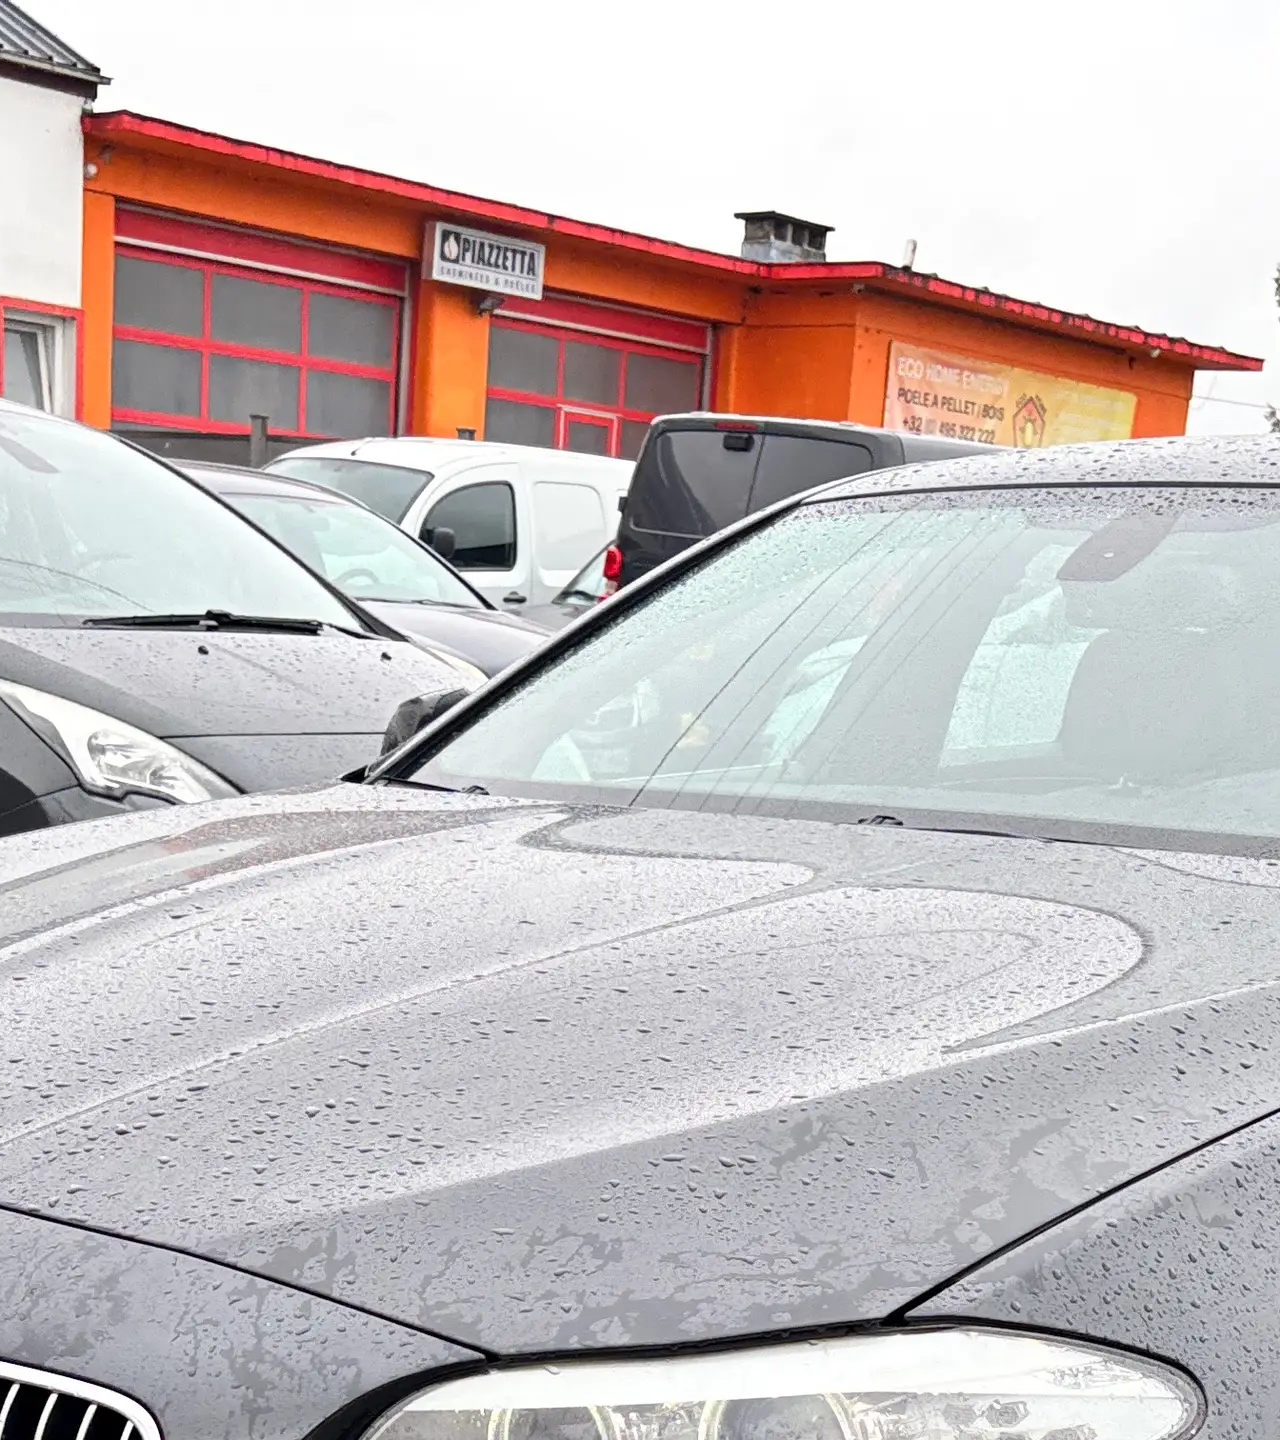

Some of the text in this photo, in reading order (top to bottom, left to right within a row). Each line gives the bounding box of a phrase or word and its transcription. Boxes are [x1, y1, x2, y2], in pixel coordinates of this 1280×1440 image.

[461, 237, 537, 277] PIAZZETTA
[941, 396, 977, 417] PELLET
[981, 404, 1005, 422] BOIS
